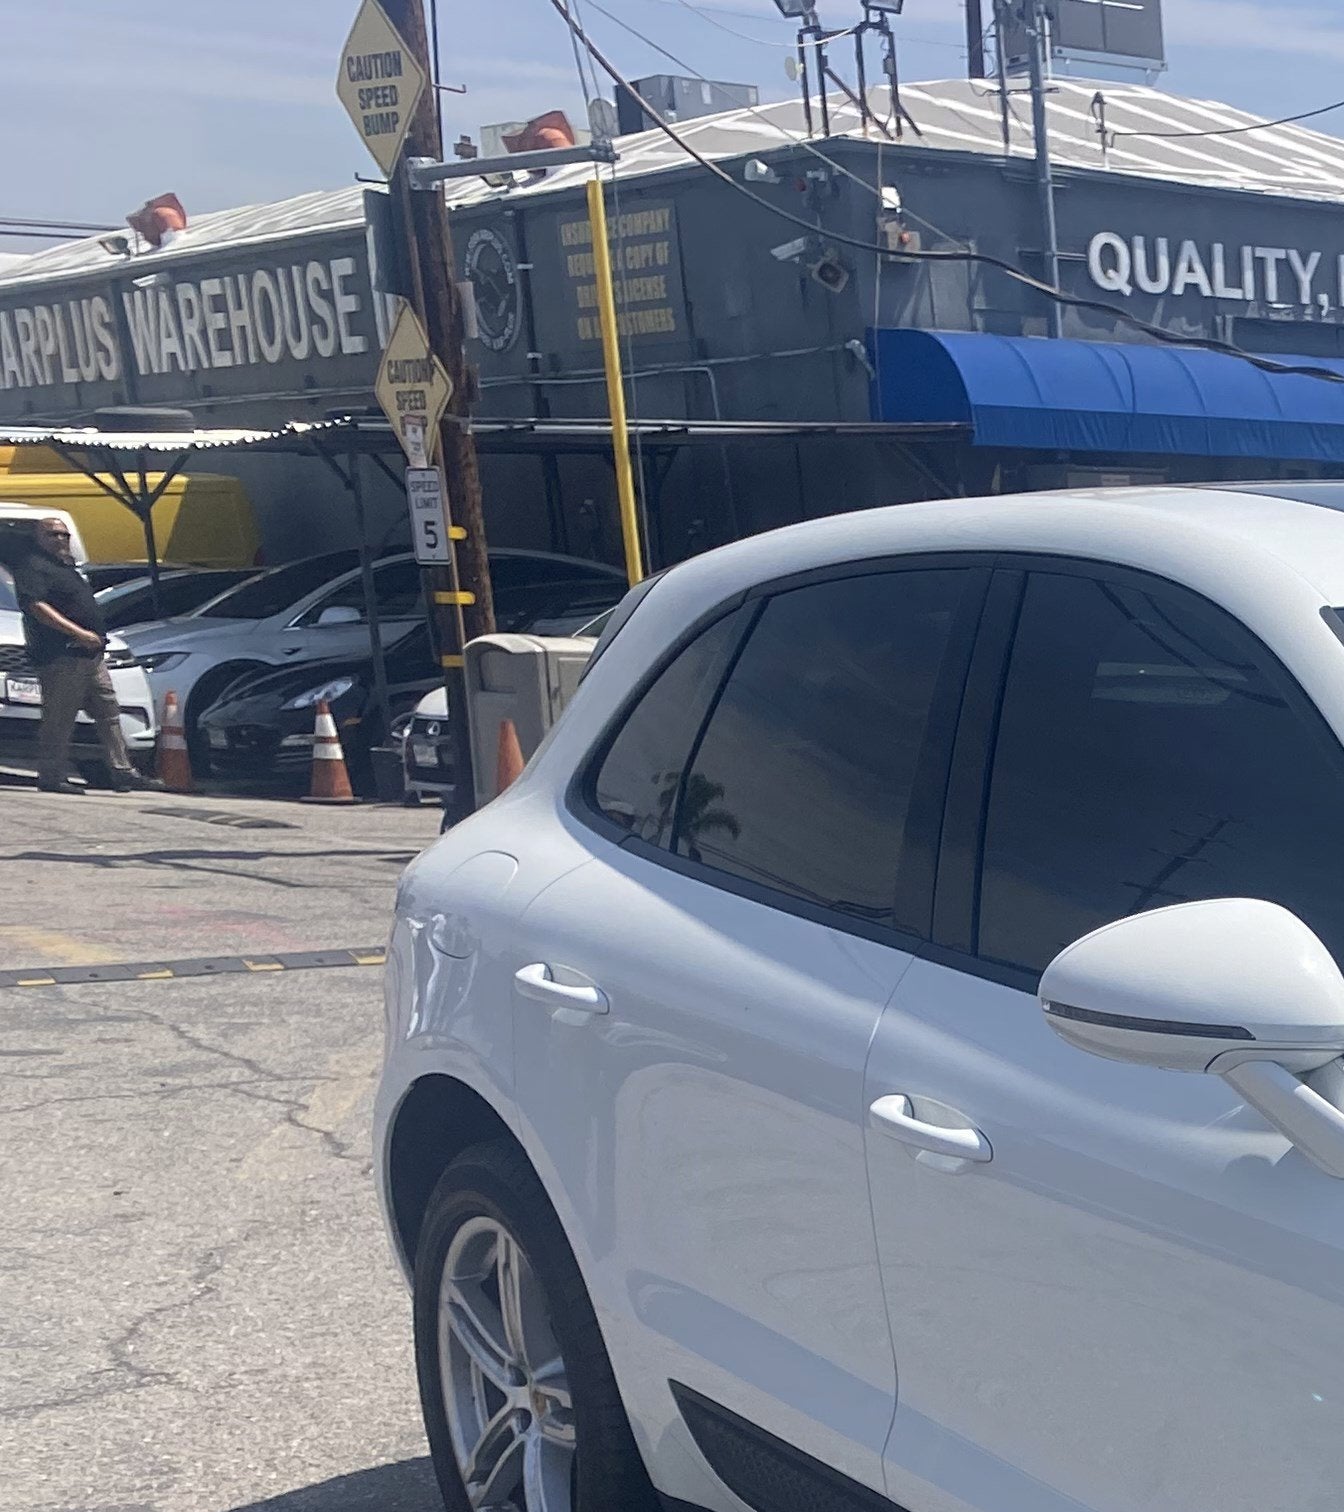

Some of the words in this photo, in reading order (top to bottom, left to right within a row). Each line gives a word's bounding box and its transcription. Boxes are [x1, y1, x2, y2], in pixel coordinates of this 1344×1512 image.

[346, 50, 403, 82] CAUTION
[358, 85, 398, 110] SPEED
[363, 111, 400, 136] BUMP
[626, 244, 653, 270] COPY
[1089, 232, 1330, 317] QUALITY,
[122, 257, 367, 376] WAREHOUSE
[387, 358, 434, 384] CAUTION
[395, 389, 426, 411] SPEED
[410, 480, 439, 492] SPEED
[415, 497, 438, 510] LIMIT
[424, 520, 438, 549] 5
